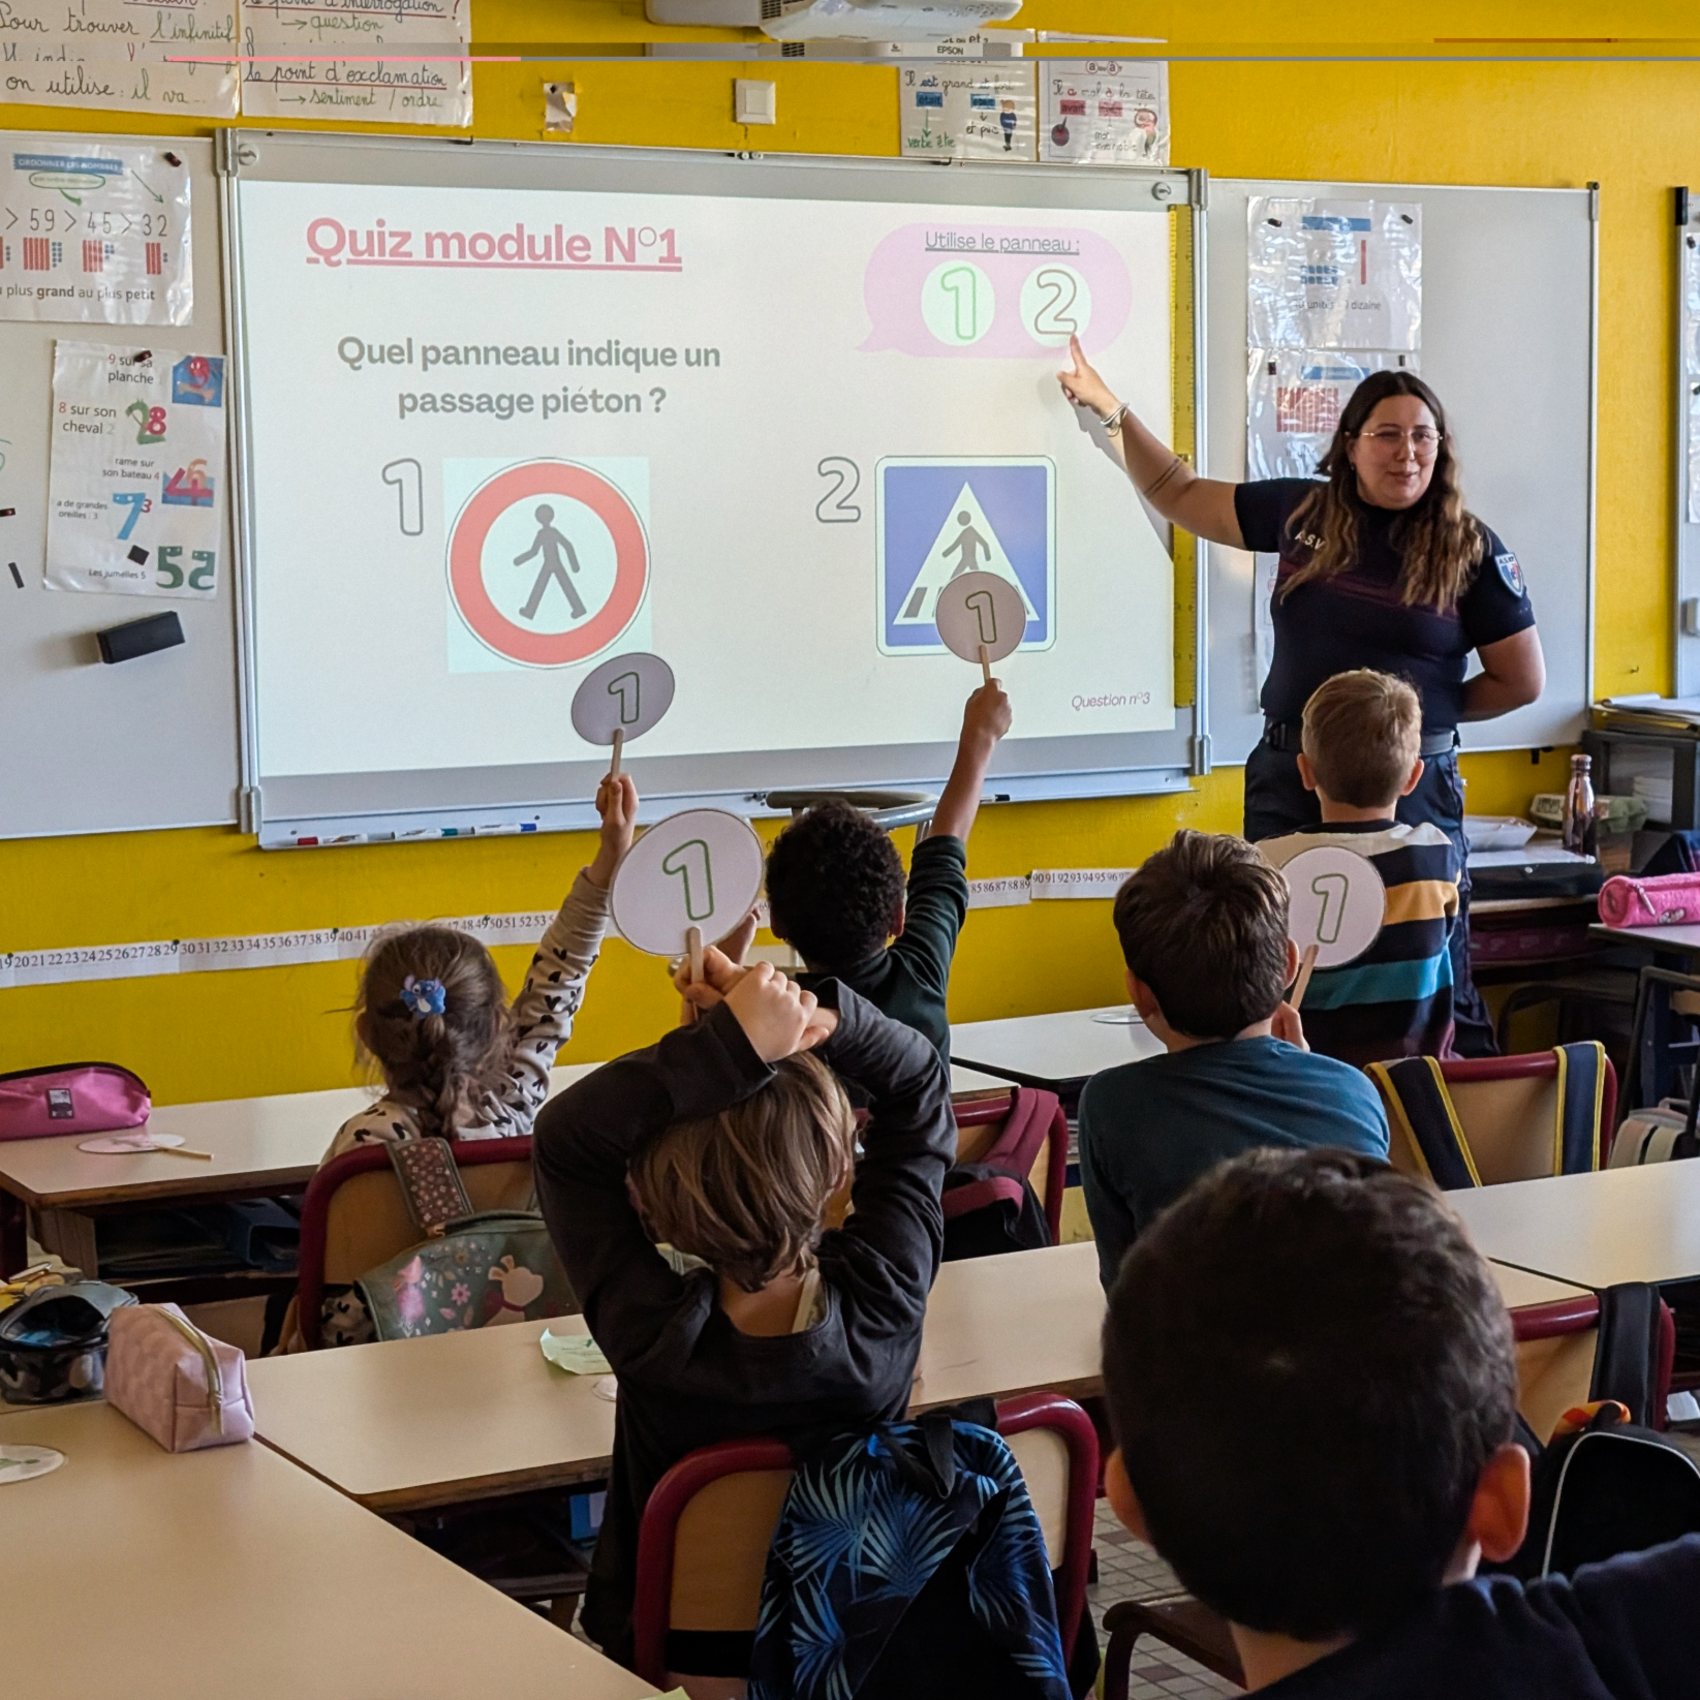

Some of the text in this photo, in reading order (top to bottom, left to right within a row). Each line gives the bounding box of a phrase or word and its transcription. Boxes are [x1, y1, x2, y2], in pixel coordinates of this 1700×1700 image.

[0, 6, 49, 33] Pour
[63, 7, 140, 35] trouver
[310, 15, 384, 41] question
[936, 45, 964, 56] EPSON
[6, 75, 36, 91] on
[46, 65, 115, 96] utilise
[131, 68, 151, 100] il
[162, 90, 188, 103] va
[270, 62, 316, 92] point
[325, 62, 447, 87] d'exclamation
[920, 76, 938, 88] est
[941, 78, 974, 96] grand
[309, 88, 376, 108] sentiment
[30, 208, 55, 232] 59
[87, 211, 112, 235] 45
[142, 213, 167, 237] 32
[306, 217, 683, 267] Quiz module N°1
[925, 231, 976, 251] Utilise
[981, 233, 995, 250] le
[1000, 237, 1072, 253] panneau
[7, 284, 155, 303] plus grand au plus petit
[940, 266, 1077, 340] 1 2
[1351, 300, 1381, 311] dizaine
[108, 353, 116, 365] 9
[337, 336, 721, 373] Quel panneau indique un
[108, 370, 154, 384] planche
[59, 402, 117, 418] 8 sur son
[398, 386, 667, 420] passage piéton ?
[62, 420, 103, 434] cheval
[115, 458, 154, 468] rame sur
[103, 469, 119, 477] son
[121, 469, 152, 480] bateau
[382, 457, 423, 537] 1
[815, 456, 861, 524] 2
[58, 510, 86, 520] oreilles
[64, 500, 74, 508] de
[76, 501, 108, 511] grandes
[104, 569, 139, 580] jumelles
[965, 590, 997, 644] 1
[607, 671, 640, 724] 1
[1071, 691, 1151, 712] Question n°3
[662, 839, 714, 921] 1
[971, 880, 1031, 893] 85 86 87 88 89
[1033, 873, 1044, 883] 90
[1045, 873, 1055, 883] 91
[1057, 873, 1069, 883] 92
[1070, 873, 1081, 883] 93
[1083, 873, 1094, 883] 94
[1095, 873, 1106, 883] 95
[1311, 873, 1349, 944] 1
[475, 918, 488, 929] 49
[490, 917, 502, 928] 50
[504, 917, 516, 928] 51
[519, 916, 532, 927] 52
[534, 915, 547, 926] 53
[14, 956, 30, 968] 20
[31, 955, 44, 967] 21
[48, 953, 63, 965] 22
[65, 951, 79, 964] 23
[81, 950, 96, 963] 24
[98, 949, 112, 961] 25
[114, 948, 129, 960] 26
[131, 946, 145, 959] 27
[147, 945, 161, 957] 28
[163, 944, 178, 956] 29
[181, 943, 195, 954] 30
[197, 942, 210, 953] 31
[214, 941, 228, 952] 32
[230, 939, 244, 952] 33
[246, 938, 260, 950] 34
[262, 937, 276, 949] 35
[278, 936, 291, 948] 36
[293, 934, 307, 946] 37
[309, 933, 322, 945] 38
[325, 932, 337, 944] 39
[340, 930, 353, 942] 40
[354, 929, 367, 941] 41
